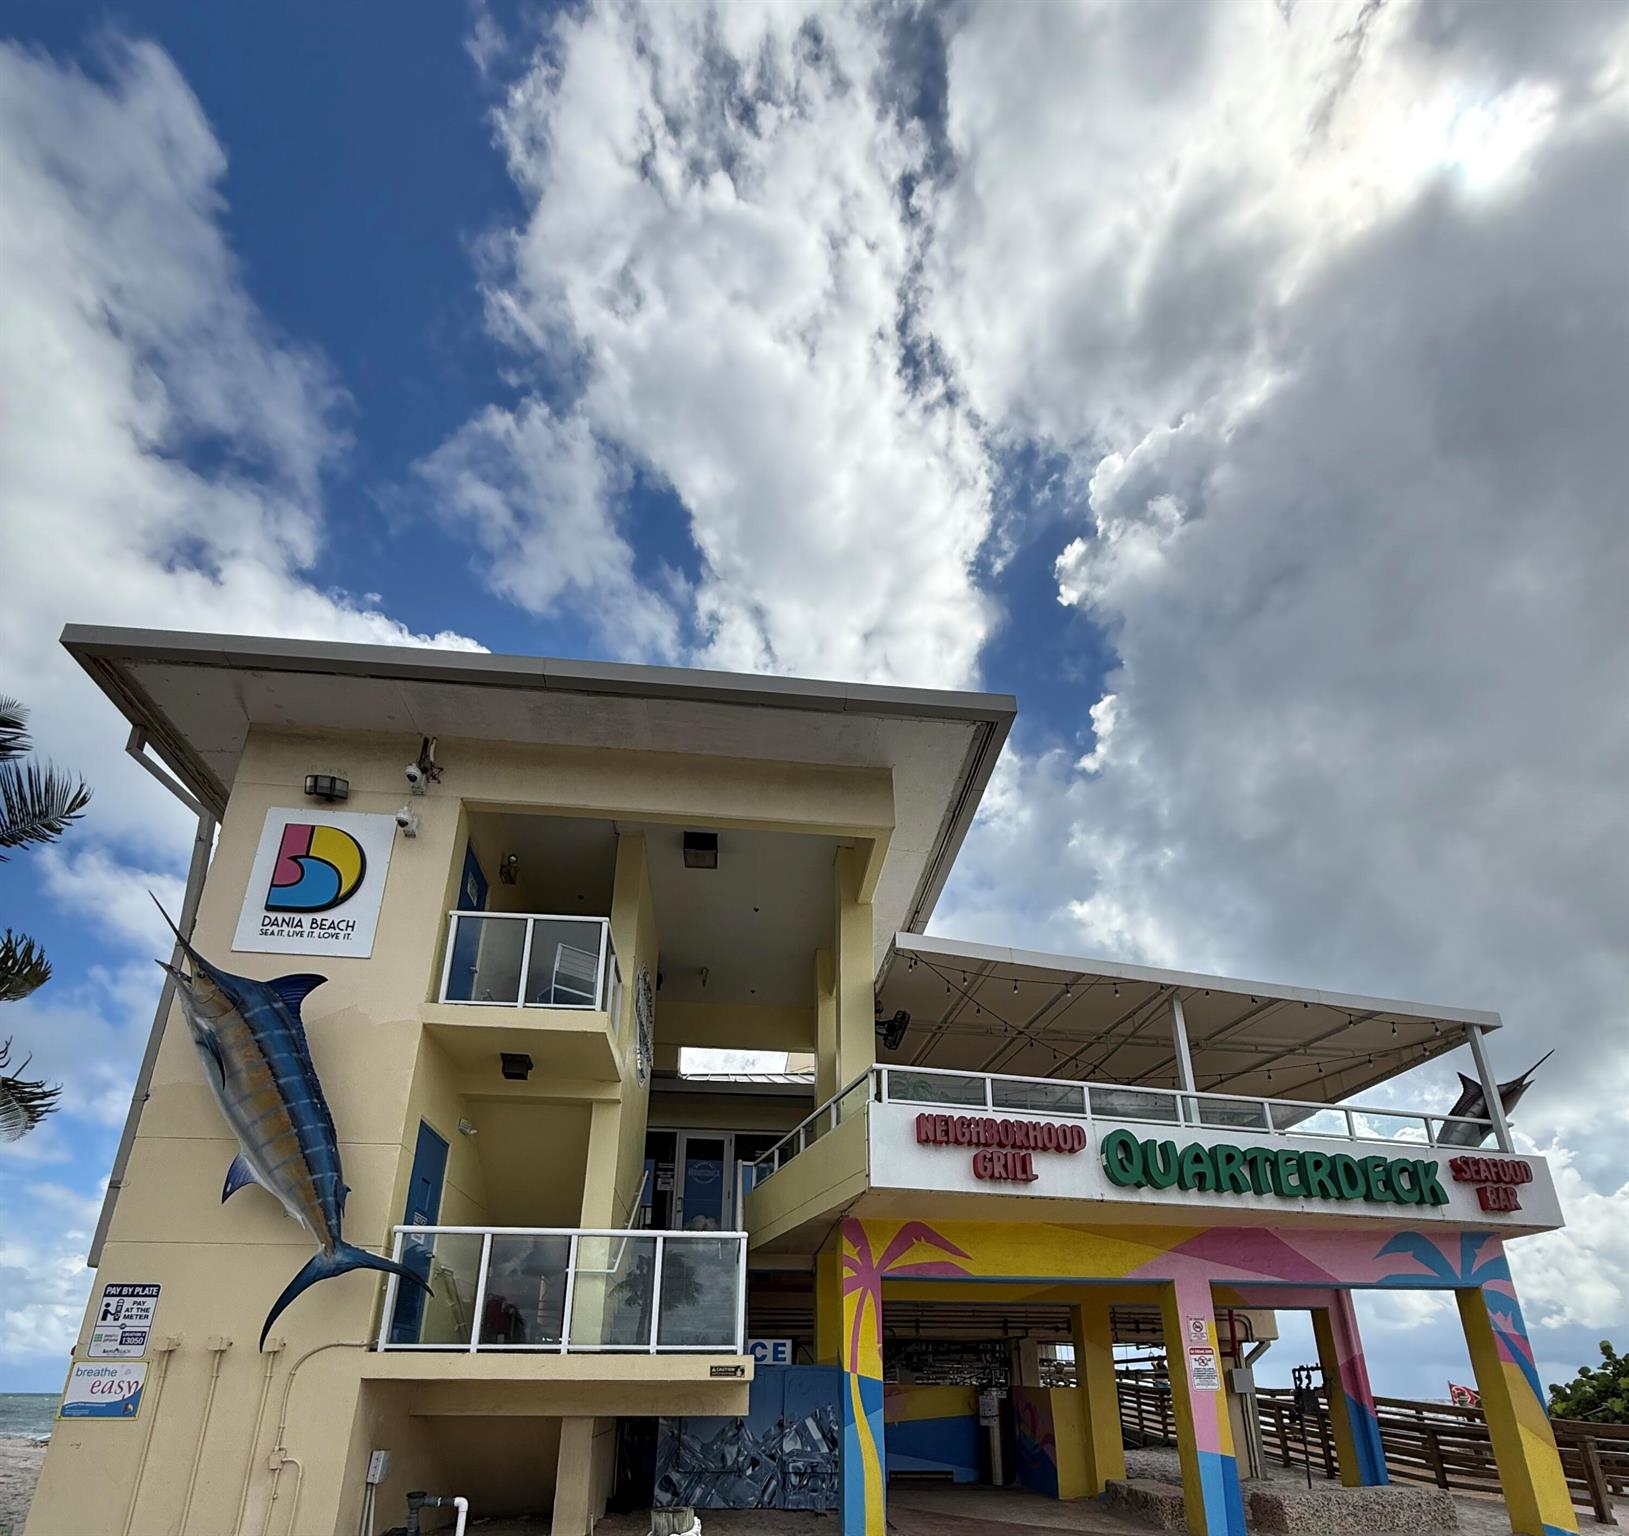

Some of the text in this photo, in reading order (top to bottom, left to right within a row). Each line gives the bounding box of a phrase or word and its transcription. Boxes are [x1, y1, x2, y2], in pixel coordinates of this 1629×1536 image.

[259, 928, 275, 936] SEA
[277, 929, 285, 937] IT.
[287, 930, 305, 938] LIVE
[318, 932, 340, 940] LOVE
[343, 933, 353, 941] IT.
[261, 915, 356, 932] DANIA BEACH
[916, 1113, 1087, 1154] NEIGHBORHOOD
[972, 1150, 1039, 1182] GRILL
[1101, 1129, 1449, 1206] QUARTERDECK
[1450, 1156, 1533, 1184] SEAFOOD
[1476, 1186, 1522, 1212] BAR
[106, 1287, 159, 1295] PAY BY PLATE
[749, 1342, 787, 1362] CE
[75, 1367, 118, 1377] breathe
[90, 1379, 140, 1401] easy
